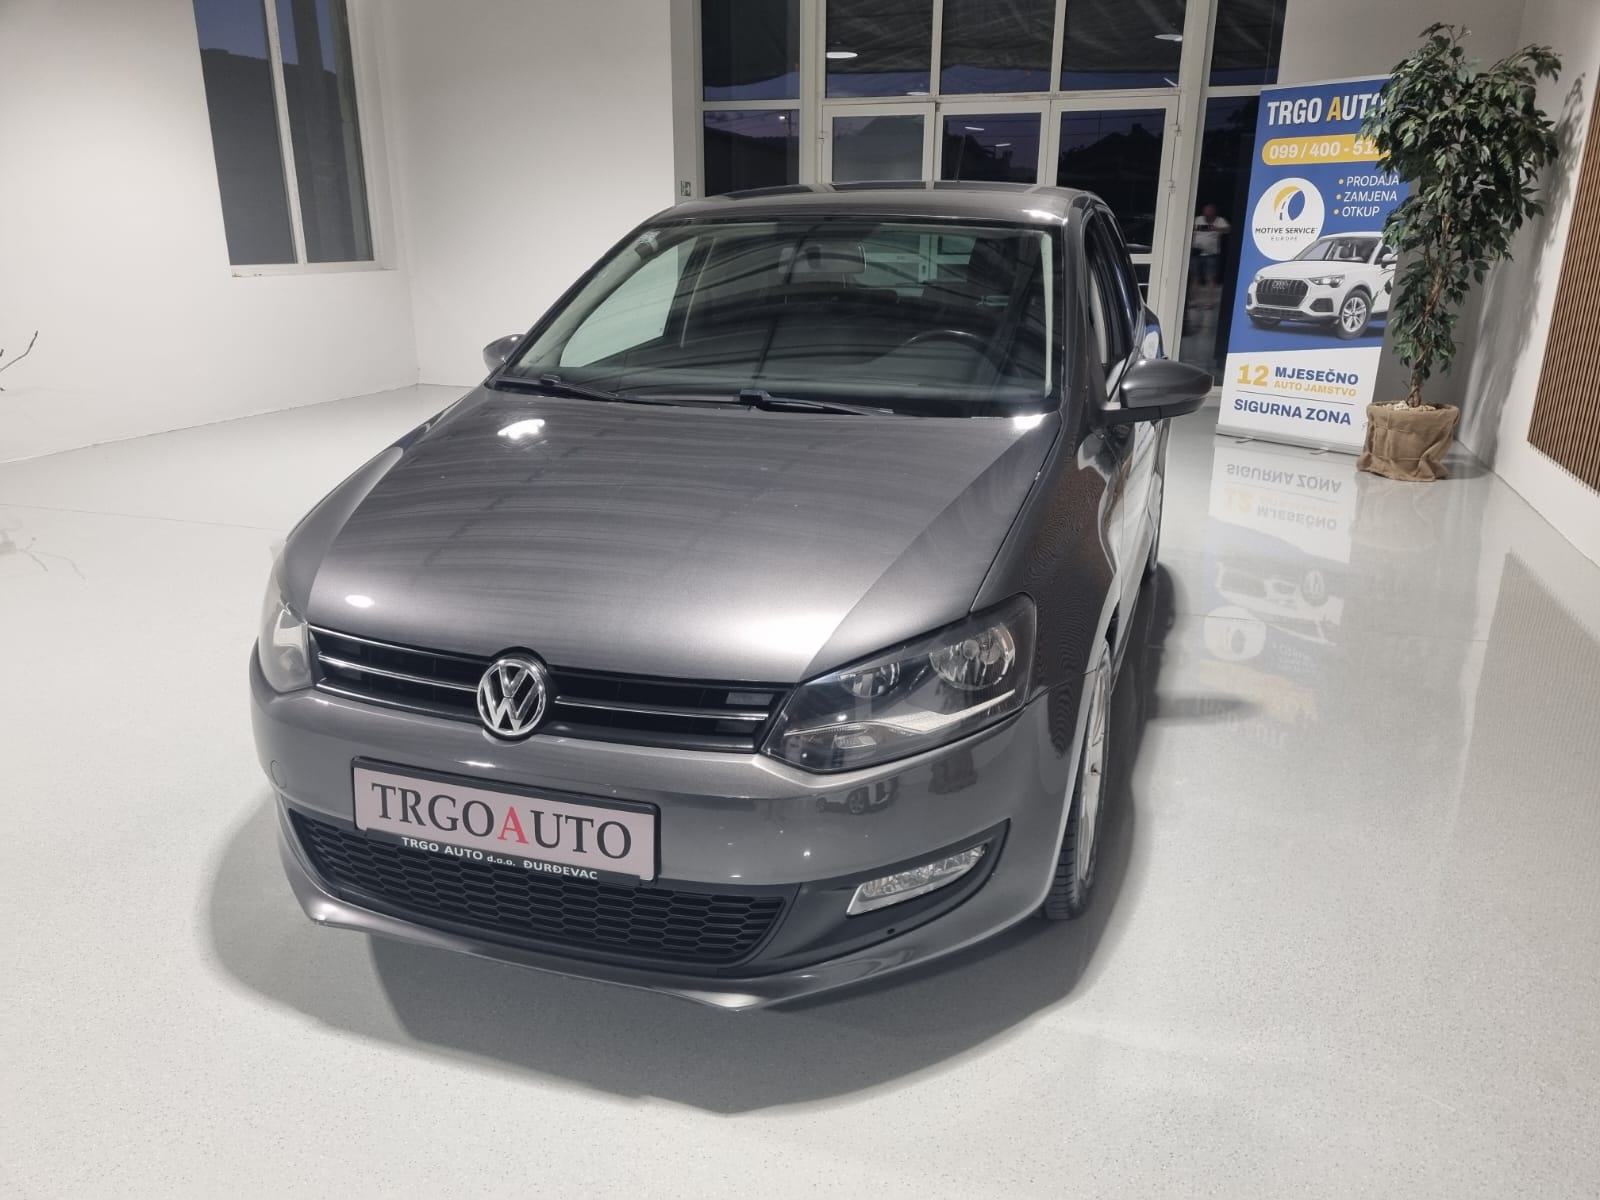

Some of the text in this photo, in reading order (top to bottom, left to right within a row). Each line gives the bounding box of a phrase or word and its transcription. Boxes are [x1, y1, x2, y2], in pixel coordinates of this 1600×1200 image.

[1267, 97, 1322, 126] TRGO
[1269, 143, 1298, 159] 099
[1311, 142, 1341, 158] 400
[1346, 175, 1400, 187] PRODAJA
[1343, 191, 1398, 202] ZAMJENA
[1342, 206, 1380, 217] OTKUP
[1237, 364, 1359, 387] 12 MJESEČNO
[1274, 380, 1357, 397] AUTO JAMSTVO
[1234, 398, 1351, 425] SIGURNA ZONA
[371, 782, 632, 859] TRGOAUTO
[401, 836, 598, 880] TRGO AUTO d.o.o. ĐURĐEVAC
